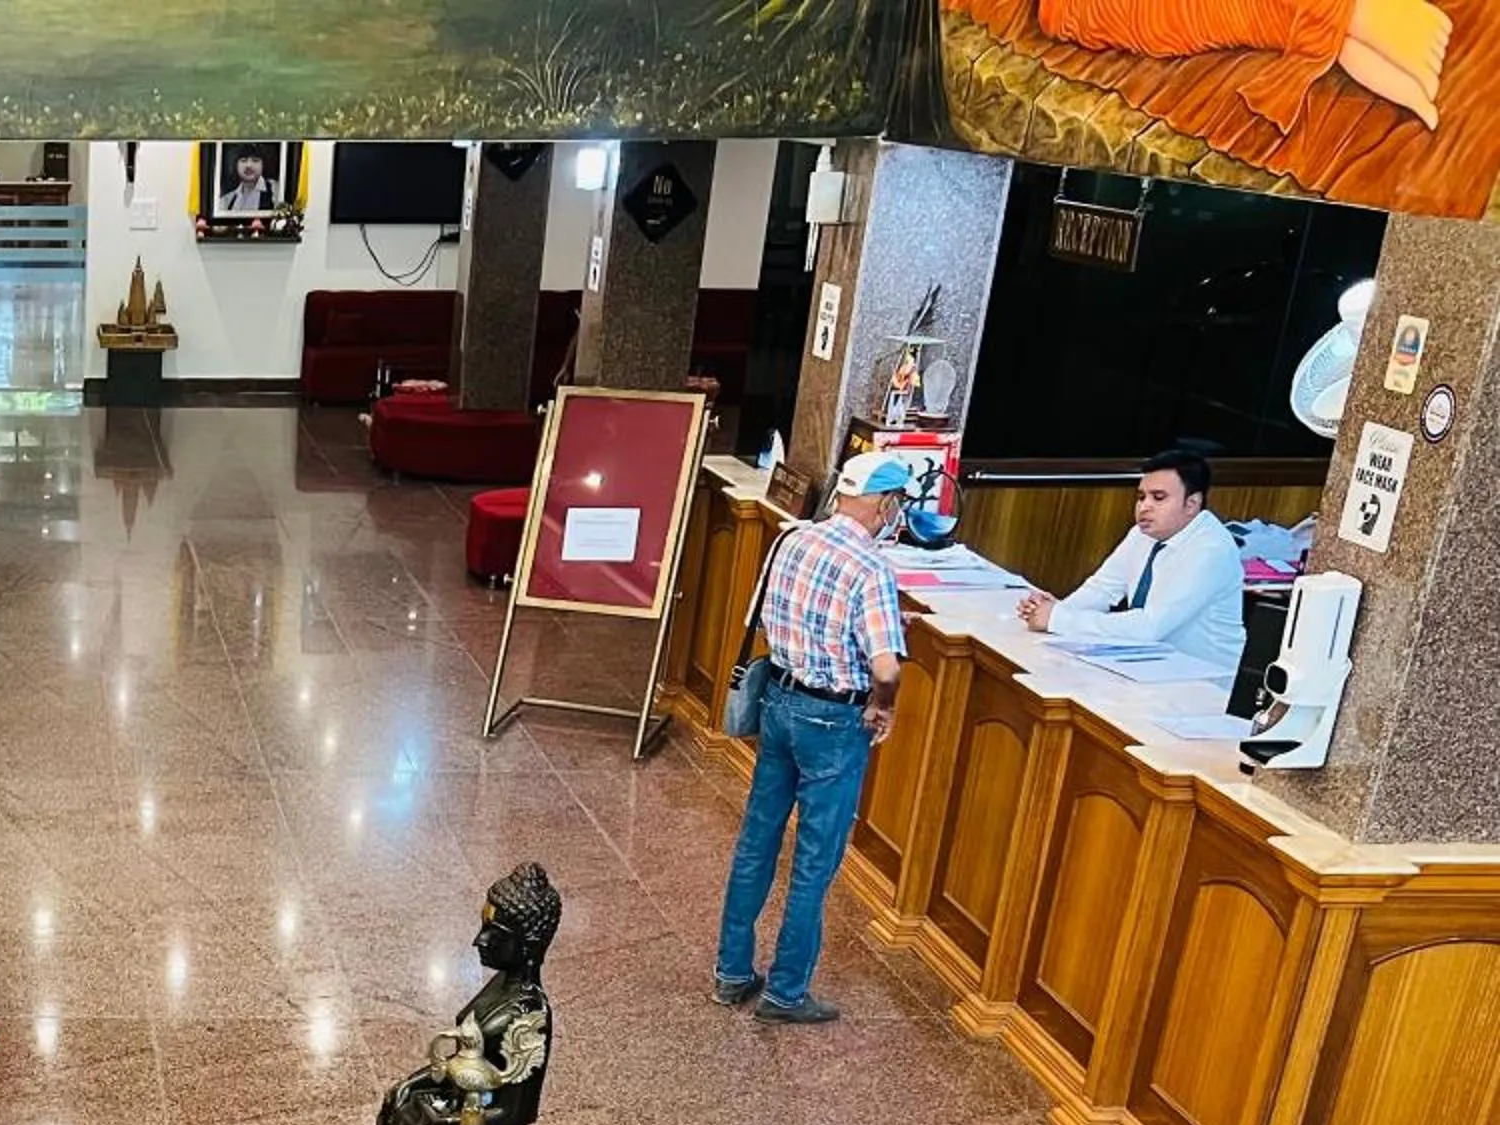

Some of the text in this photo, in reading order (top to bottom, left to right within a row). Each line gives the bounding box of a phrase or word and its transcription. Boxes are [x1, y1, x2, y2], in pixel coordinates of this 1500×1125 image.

[1055, 209, 1133, 263] RECEPTION
[1369, 452, 1393, 473] WEAR
[1355, 467, 1399, 493] FACE MASK
